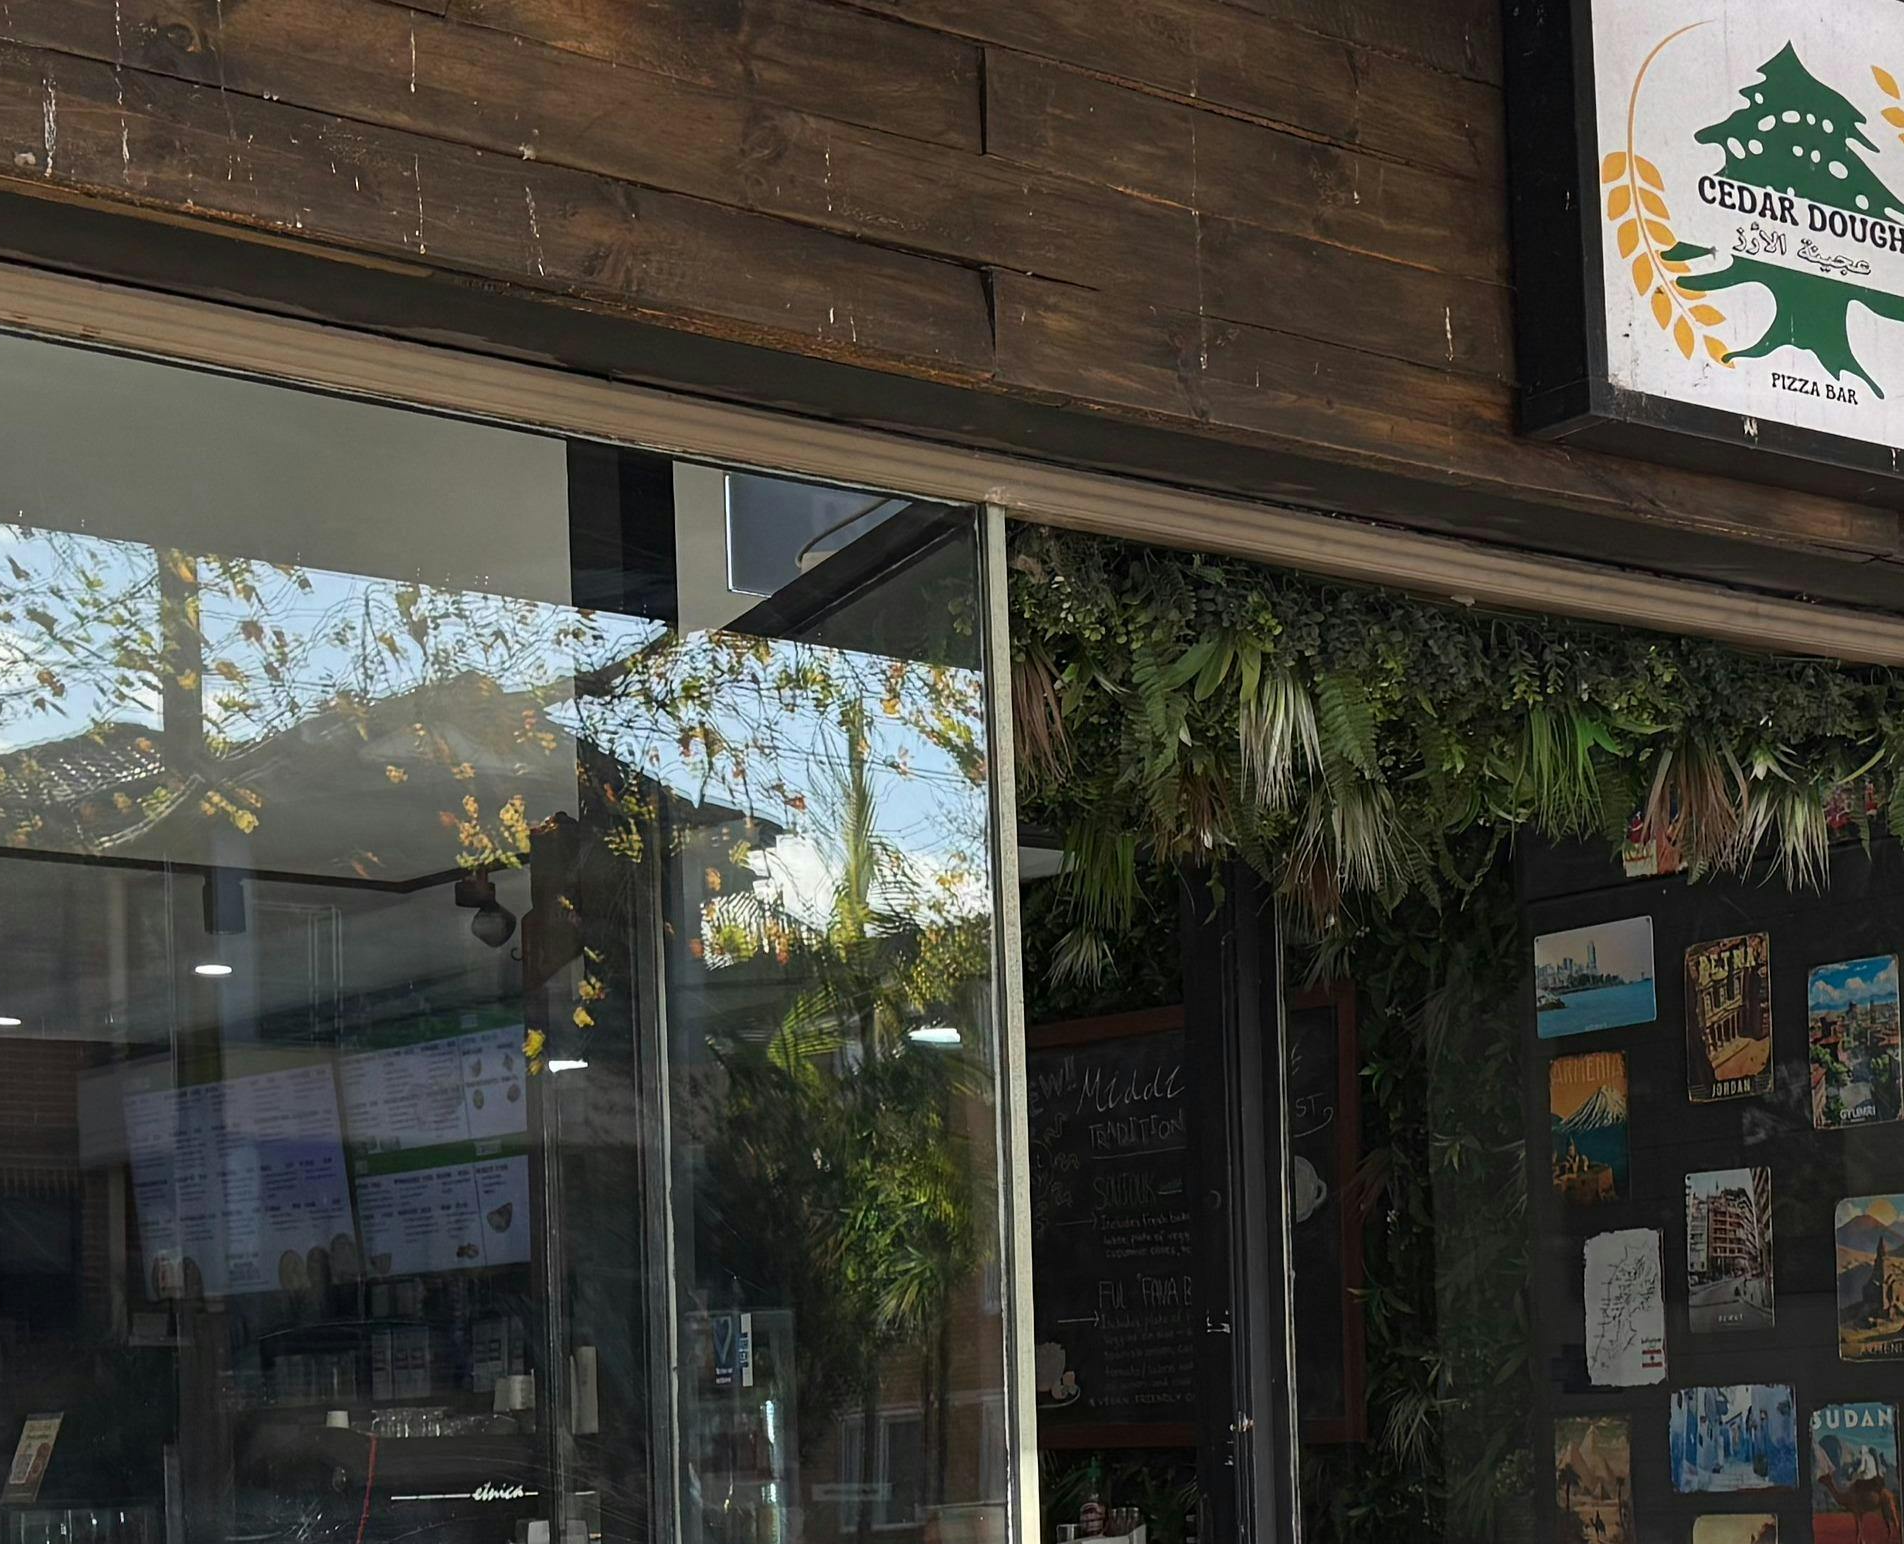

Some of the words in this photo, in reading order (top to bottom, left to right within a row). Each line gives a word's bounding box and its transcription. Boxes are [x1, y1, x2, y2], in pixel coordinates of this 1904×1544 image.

[1698, 176, 1799, 226] CEDAR
[1771, 372, 1820, 398] PIZZA
[1825, 382, 1859, 406] BAR
[1697, 948, 1758, 981] PETRA
[1551, 1053, 1624, 1084] ARMENIA
[1076, 1064, 1185, 1113] Middl
[1710, 1079, 1751, 1096] JORDAN
[1089, 1108, 1184, 1149] TRADITION
[1810, 1405, 1893, 1431] SUDAN
